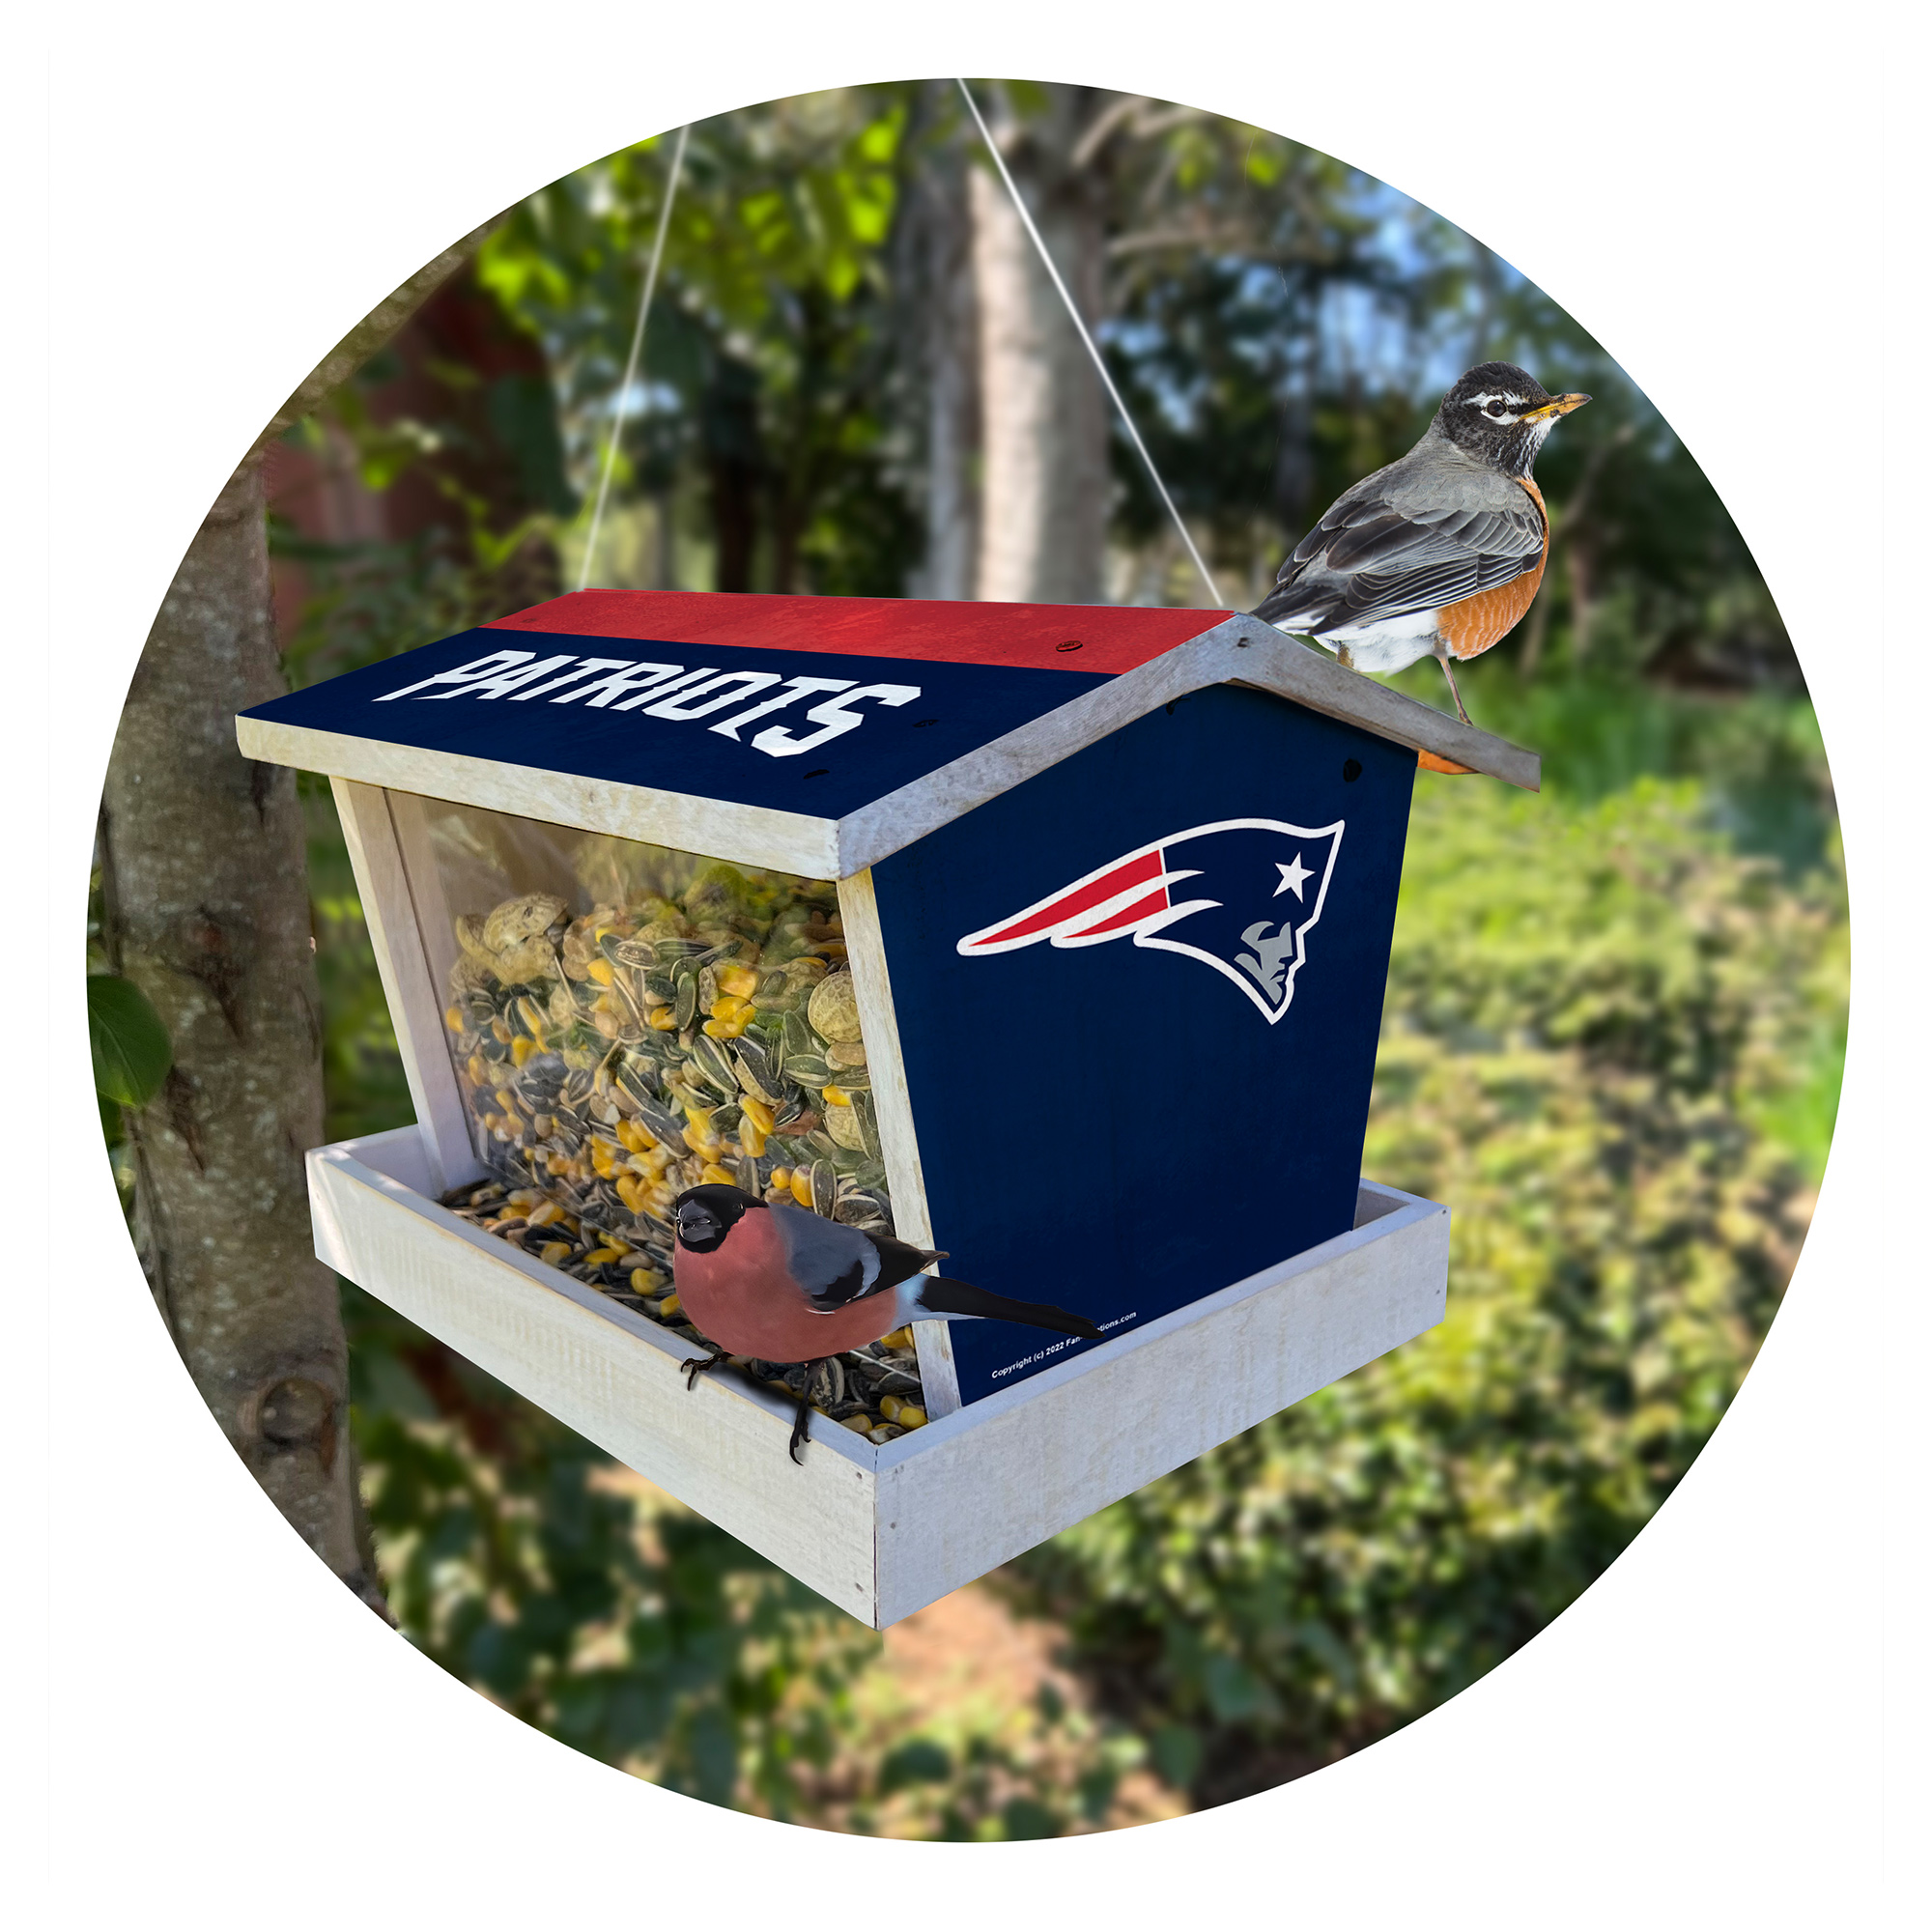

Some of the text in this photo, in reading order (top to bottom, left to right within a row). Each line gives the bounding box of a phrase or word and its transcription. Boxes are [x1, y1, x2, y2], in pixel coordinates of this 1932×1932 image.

[371, 649, 922, 758] PATRIOTS
[991, 1356, 1033, 1378] Copyright
[1034, 1350, 1045, 1363] (c)
[1046, 1342, 1065, 1356] 2022
